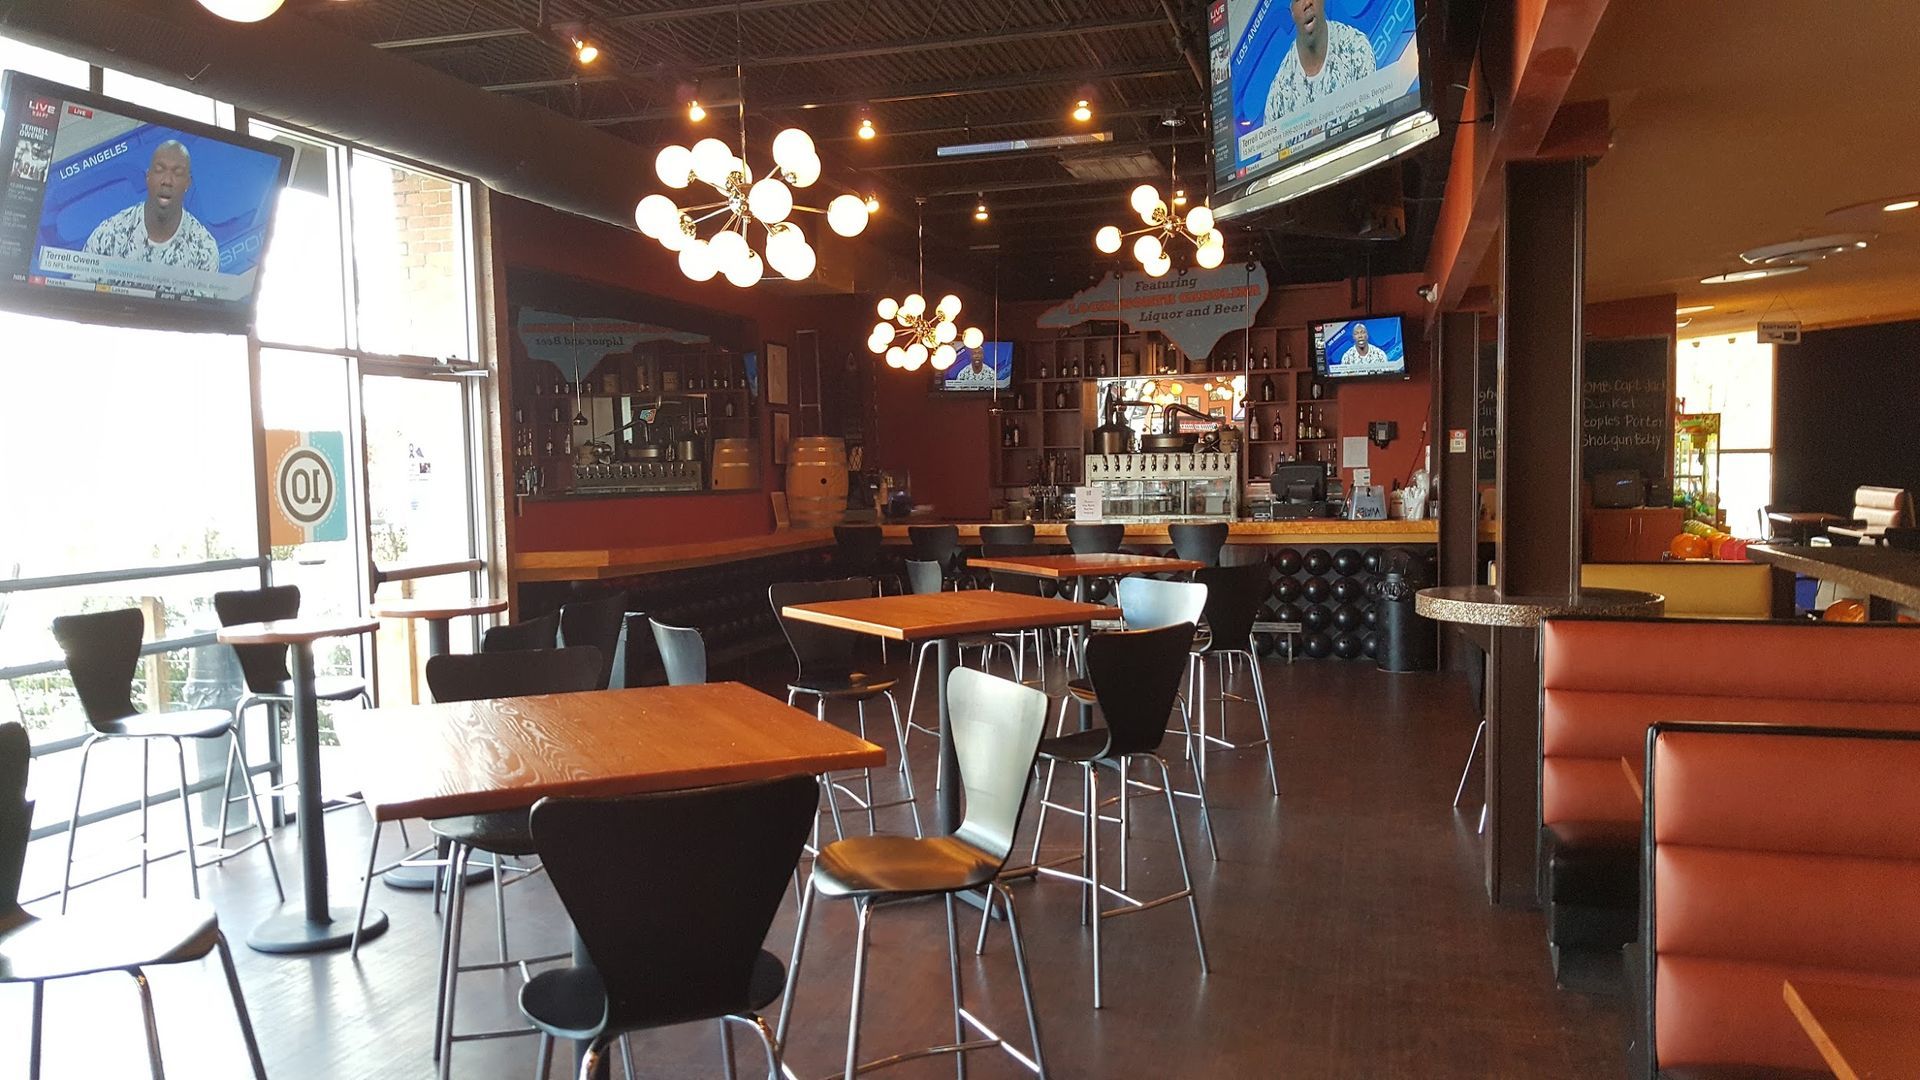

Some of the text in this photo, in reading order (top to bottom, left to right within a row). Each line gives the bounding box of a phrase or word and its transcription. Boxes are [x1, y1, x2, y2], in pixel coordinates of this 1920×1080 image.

[1210, 3, 1225, 20] LIVE
[1235, 44, 1249, 66] LOS
[28, 100, 56, 115] LIVE
[73, 108, 87, 117] LIVE
[1242, 126, 1278, 148] Terrell Owens
[59, 141, 129, 180] LOS ANGELES
[219, 231, 263, 267] SPO
[46, 251, 100, 266] Terrell Owens
[12, 273, 26, 281] NBA
[1134, 275, 1199, 292] Featuring
[1139, 302, 1246, 324] Liquor and Beer
[1583, 413, 1664, 429] eoples Porter
[1583, 433, 1632, 452] Shotgun
